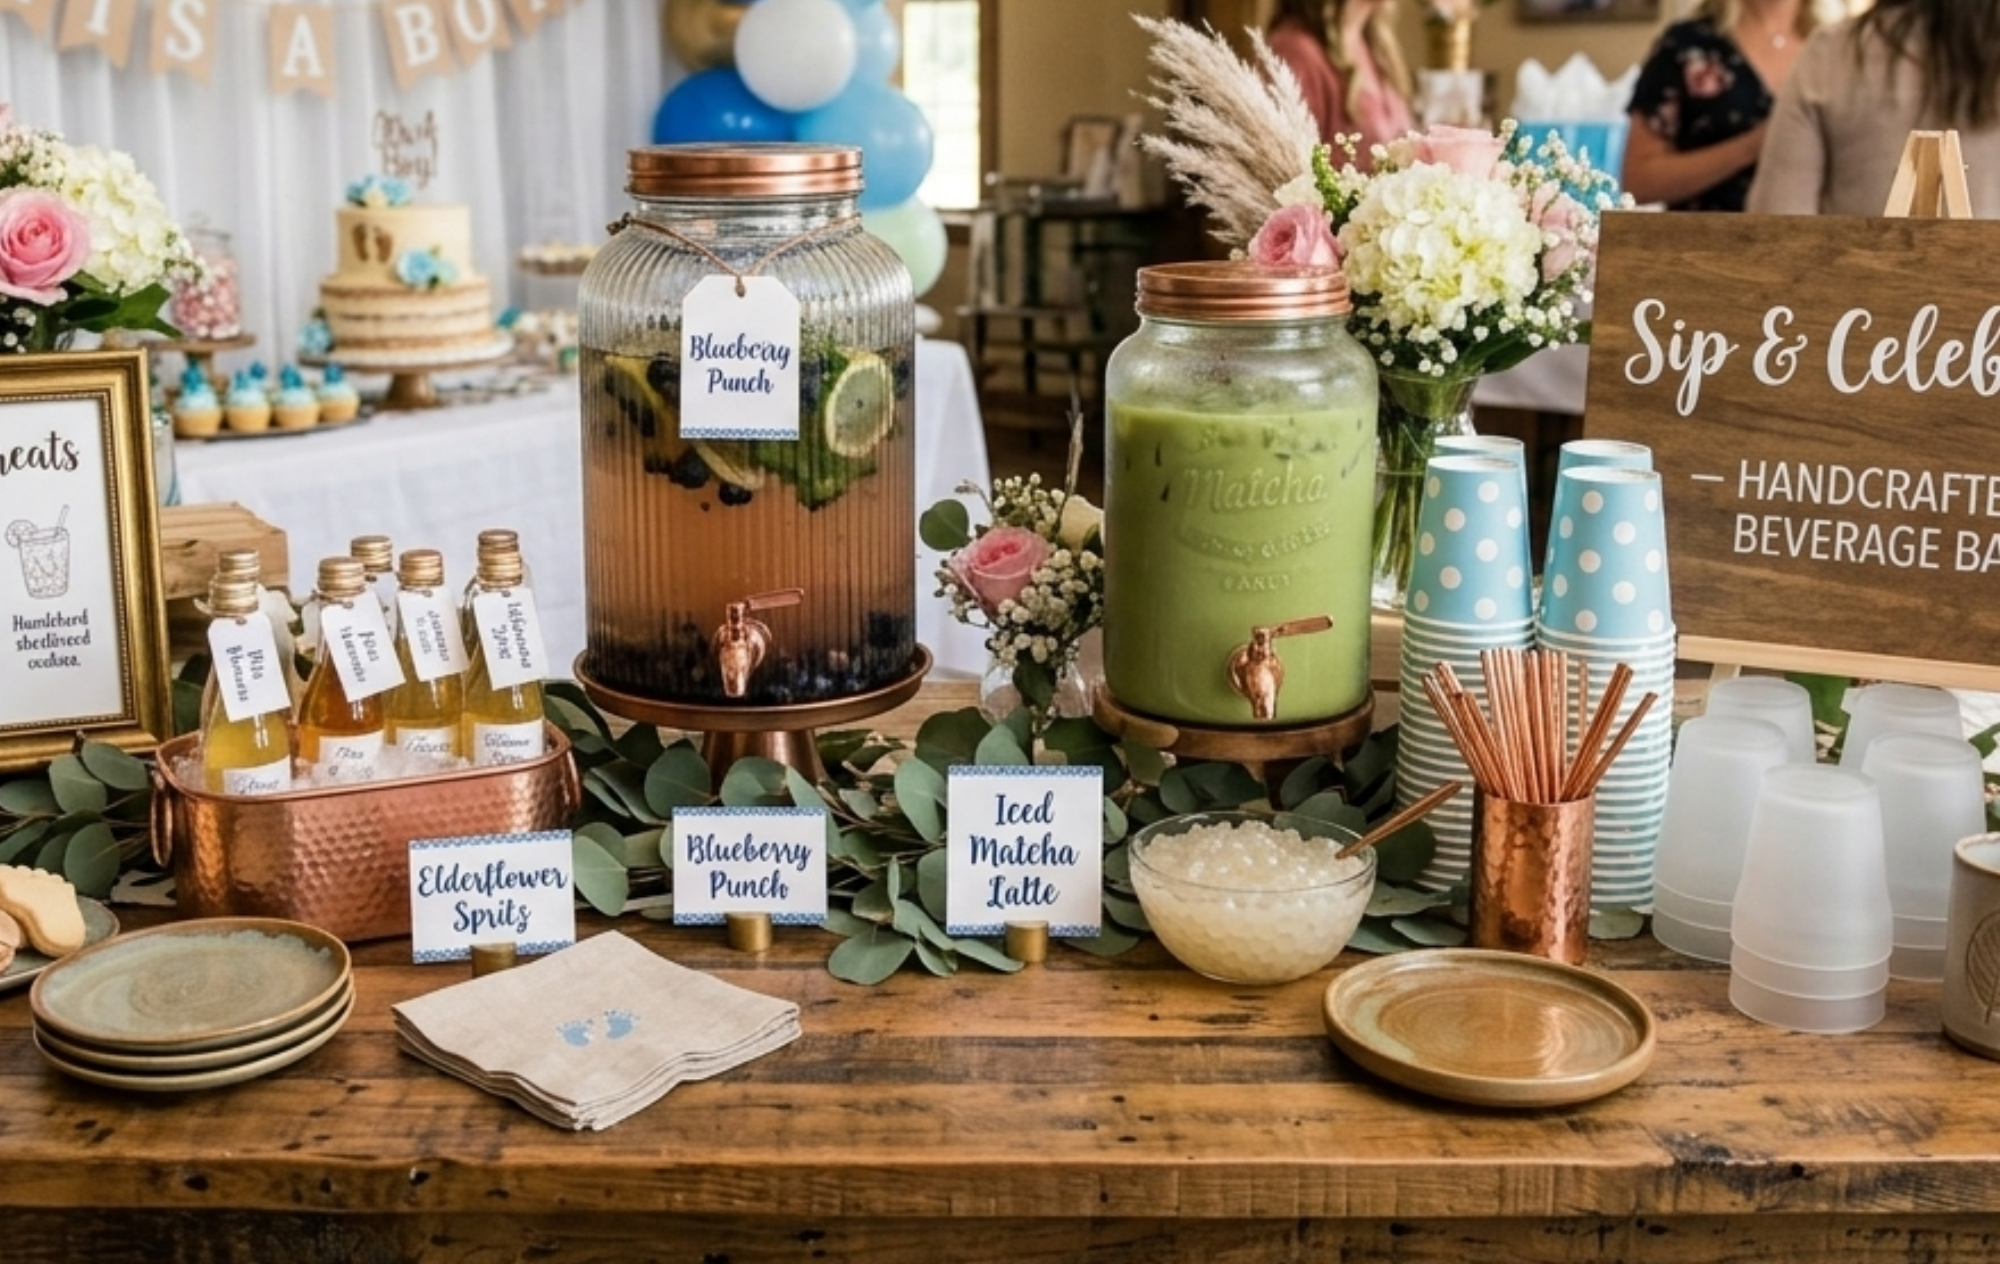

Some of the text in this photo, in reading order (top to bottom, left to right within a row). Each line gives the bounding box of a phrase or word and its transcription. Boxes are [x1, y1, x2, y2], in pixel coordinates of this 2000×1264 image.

[281, 13, 325, 77] A
[395, 3, 546, 67] BO
[1625, 299, 1739, 417] Sip
[1753, 305, 1808, 387] &
[706, 367, 774, 395] Punch
[1733, 513, 1942, 570] BEVERAGE
[995, 790, 1055, 826] Iced
[687, 833, 813, 872] Blueberry
[969, 831, 1080, 868] Matcha
[417, 860, 568, 898] Elderflower
[709, 868, 789, 900] Punch
[986, 874, 1060, 910] Latte
